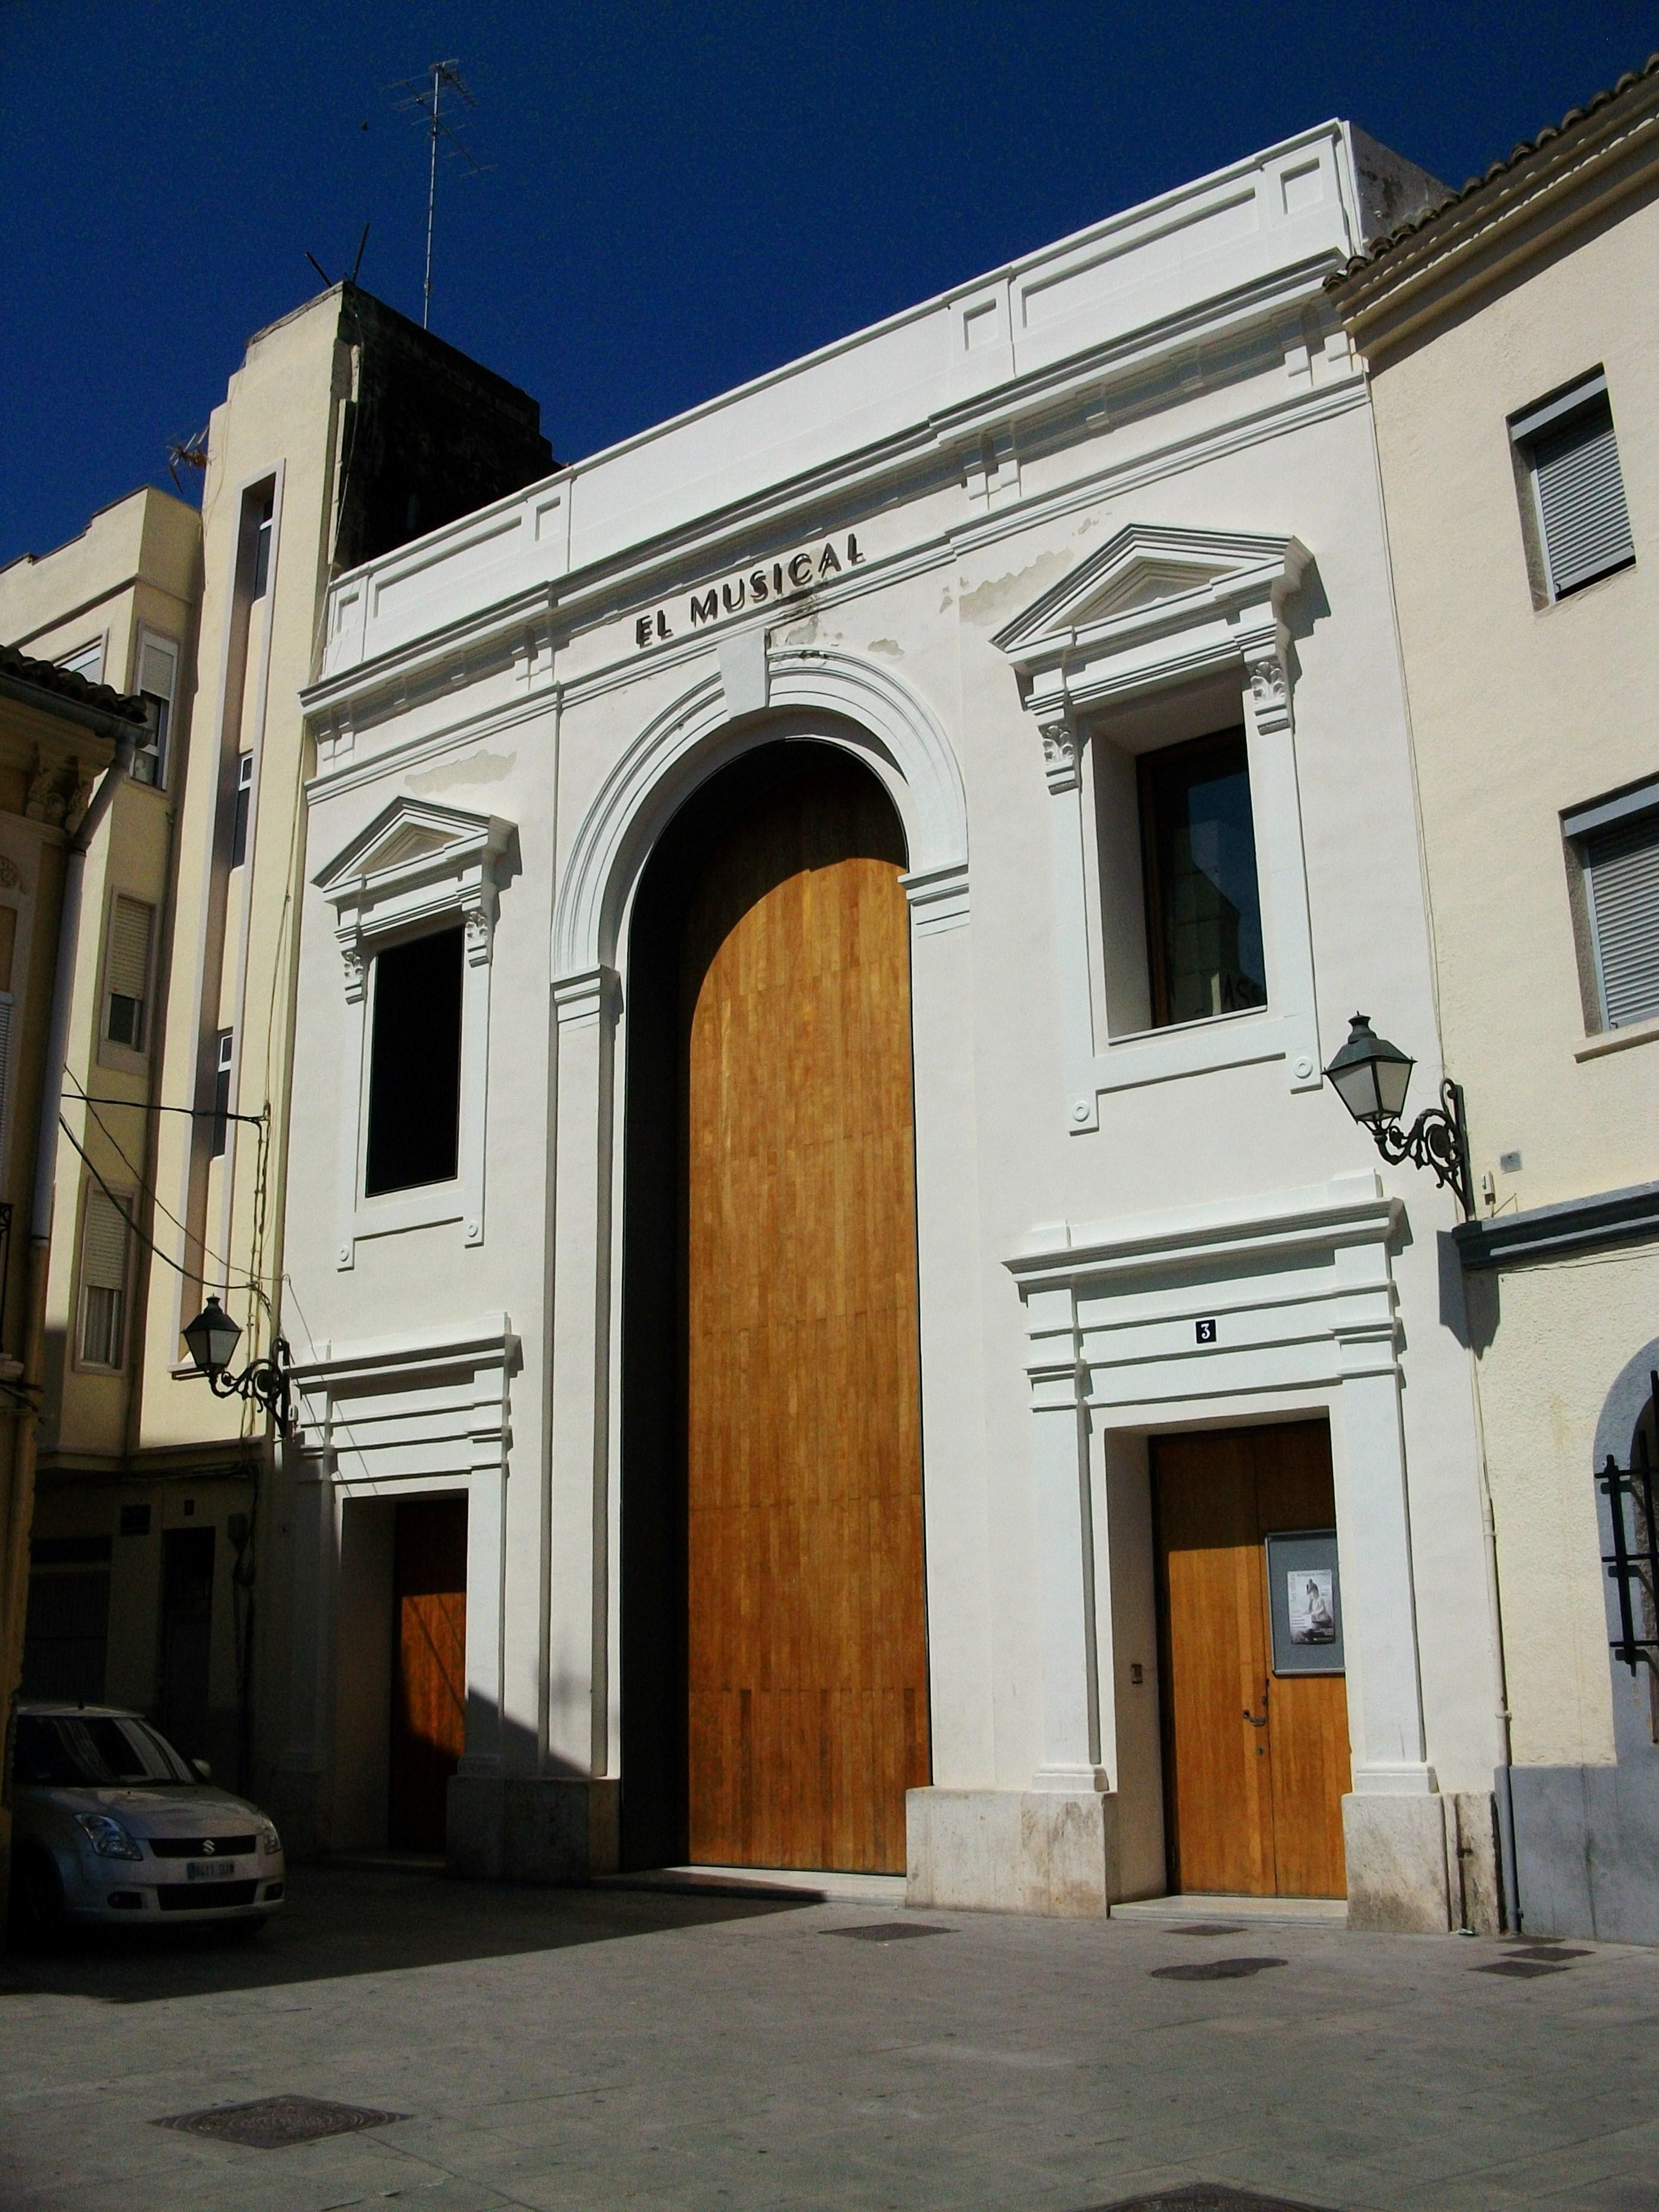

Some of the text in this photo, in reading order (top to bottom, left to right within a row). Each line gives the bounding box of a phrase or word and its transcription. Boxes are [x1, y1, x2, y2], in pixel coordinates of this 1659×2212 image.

[636, 533, 866, 648] EL MUSICAL
[1201, 1323, 1210, 1339] 3
